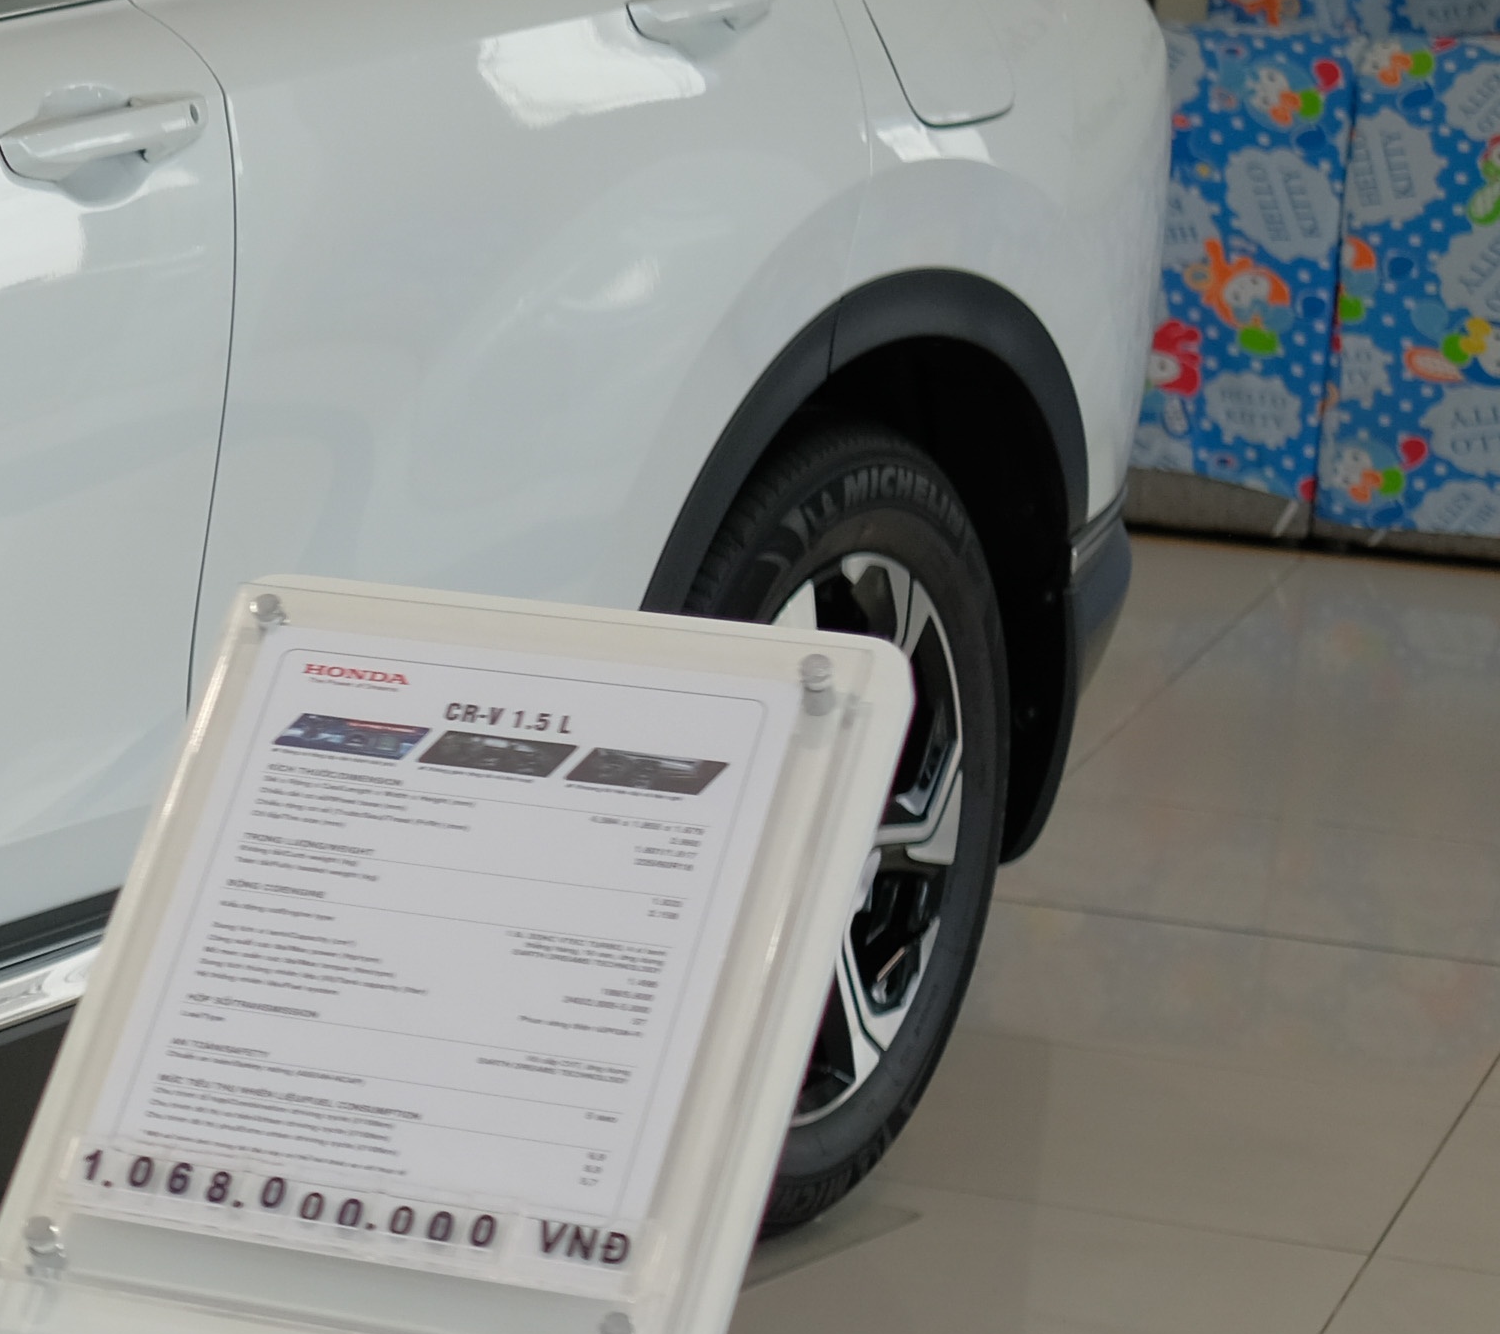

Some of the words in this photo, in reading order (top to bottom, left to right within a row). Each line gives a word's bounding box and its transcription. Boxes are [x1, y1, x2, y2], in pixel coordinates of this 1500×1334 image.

[843, 464, 967, 540] MICHELIN
[303, 663, 410, 686] HONDA
[444, 702, 504, 726] CR-V
[513, 710, 550, 732] 1.5
[558, 714, 573, 735] L
[81, 1148, 497, 1249] 1.068.000.000
[538, 1218, 632, 1267] VNĐ
